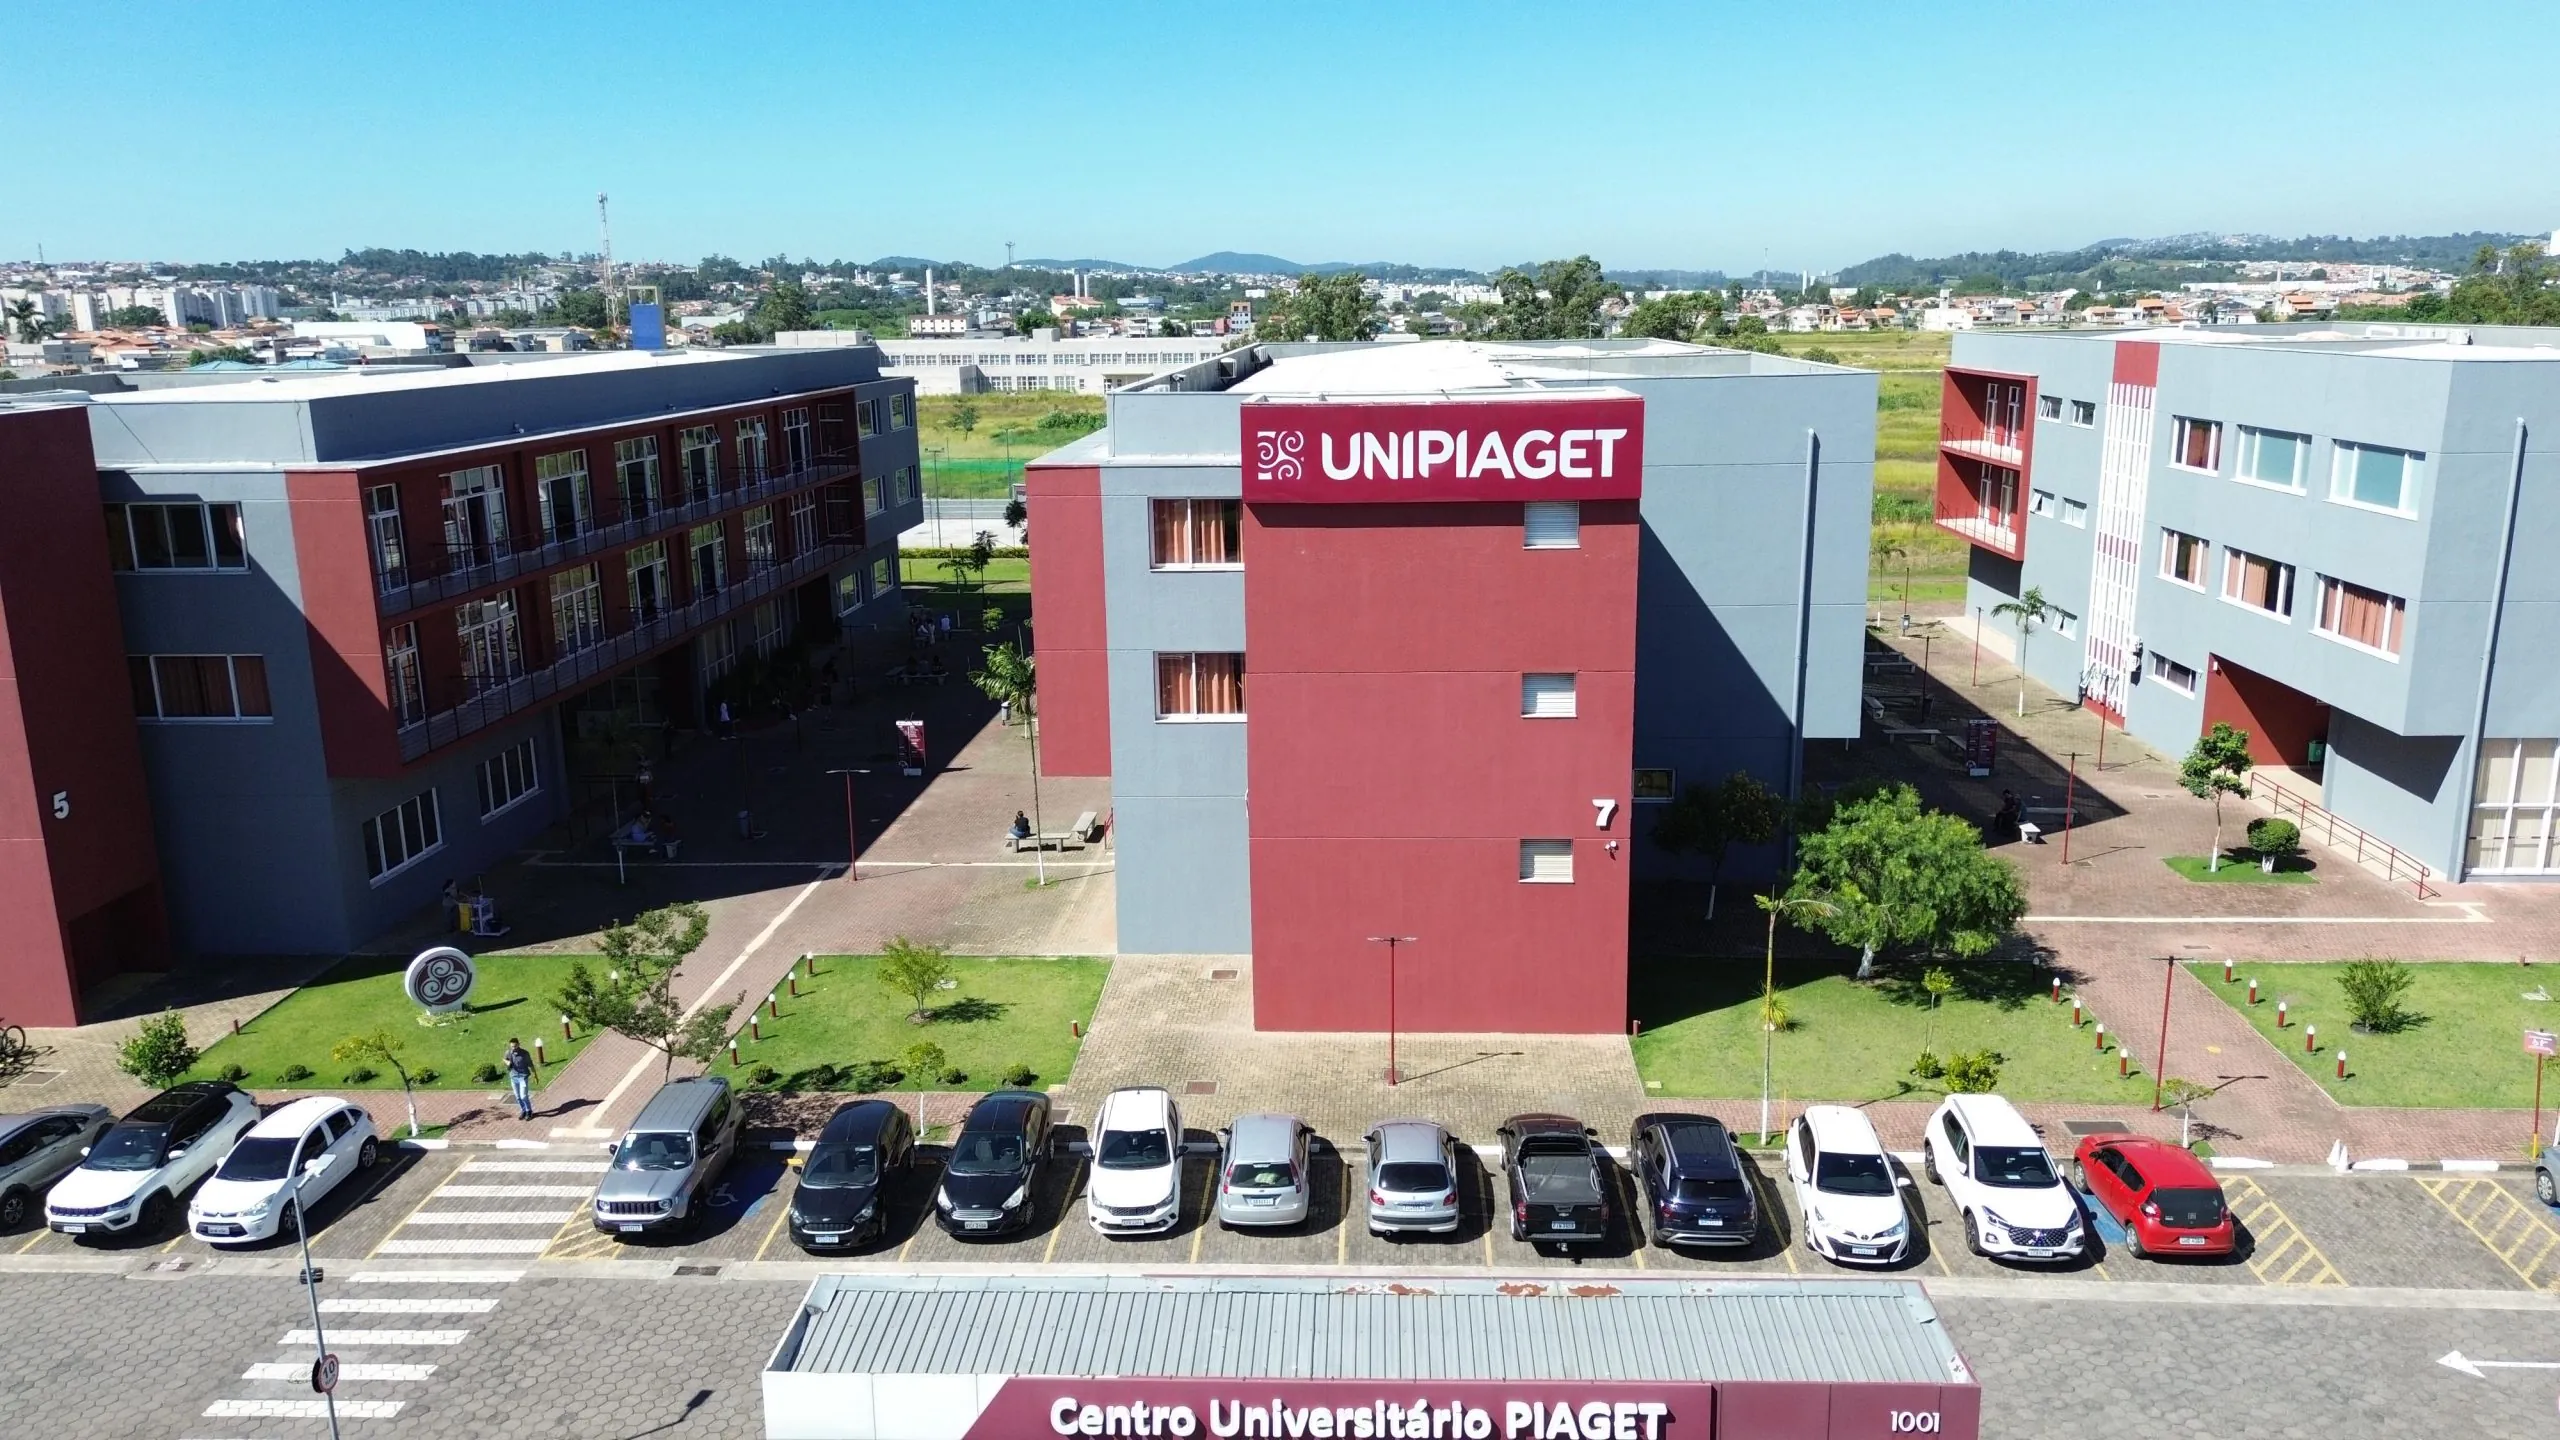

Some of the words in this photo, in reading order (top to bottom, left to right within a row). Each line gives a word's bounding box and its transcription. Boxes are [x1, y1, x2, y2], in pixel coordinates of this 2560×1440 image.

[1321, 428, 1628, 480] UNIPIAGET
[53, 790, 69, 819] 5
[1592, 799, 1616, 827] 7
[323, 1360, 335, 1379] 10
[1050, 1397, 1197, 1437] Centro
[1209, 1398, 1492, 1439] Universitário
[1505, 1400, 1668, 1440] PIAGET
[1890, 1411, 1940, 1432] 1001
